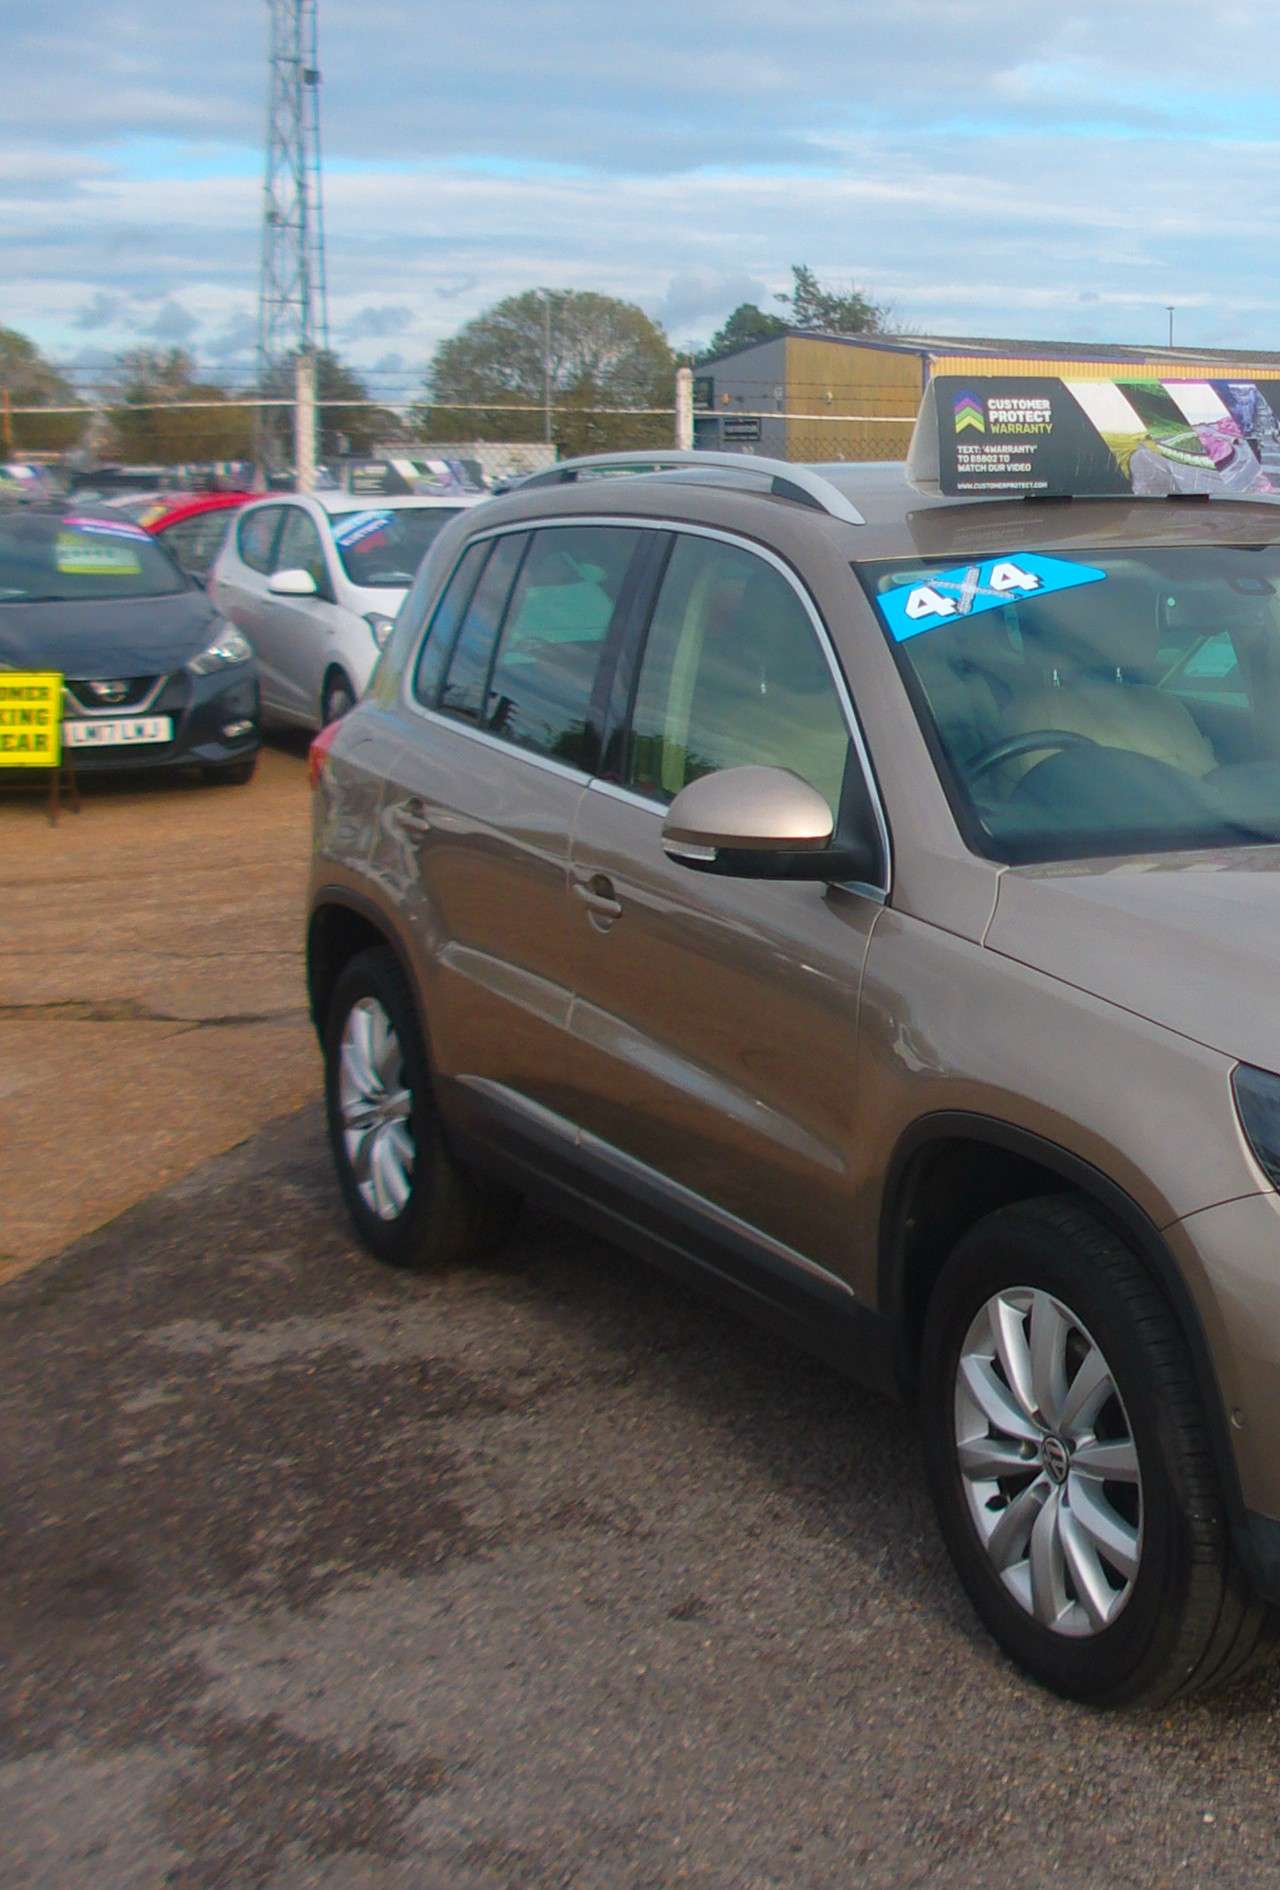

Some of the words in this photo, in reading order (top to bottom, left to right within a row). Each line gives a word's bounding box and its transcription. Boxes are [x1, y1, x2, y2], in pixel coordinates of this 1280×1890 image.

[987, 398, 1051, 410] CUSTOMER
[988, 410, 1052, 422] PROTECT
[990, 423, 1053, 434] WARRANTY
[957, 445, 982, 454] TEXT:
[957, 455, 969, 463] TO
[999, 455, 1011, 463] TO
[957, 464, 987, 473] WATCH
[988, 464, 1005, 472] OUR
[1006, 463, 1032, 472] VIDEO
